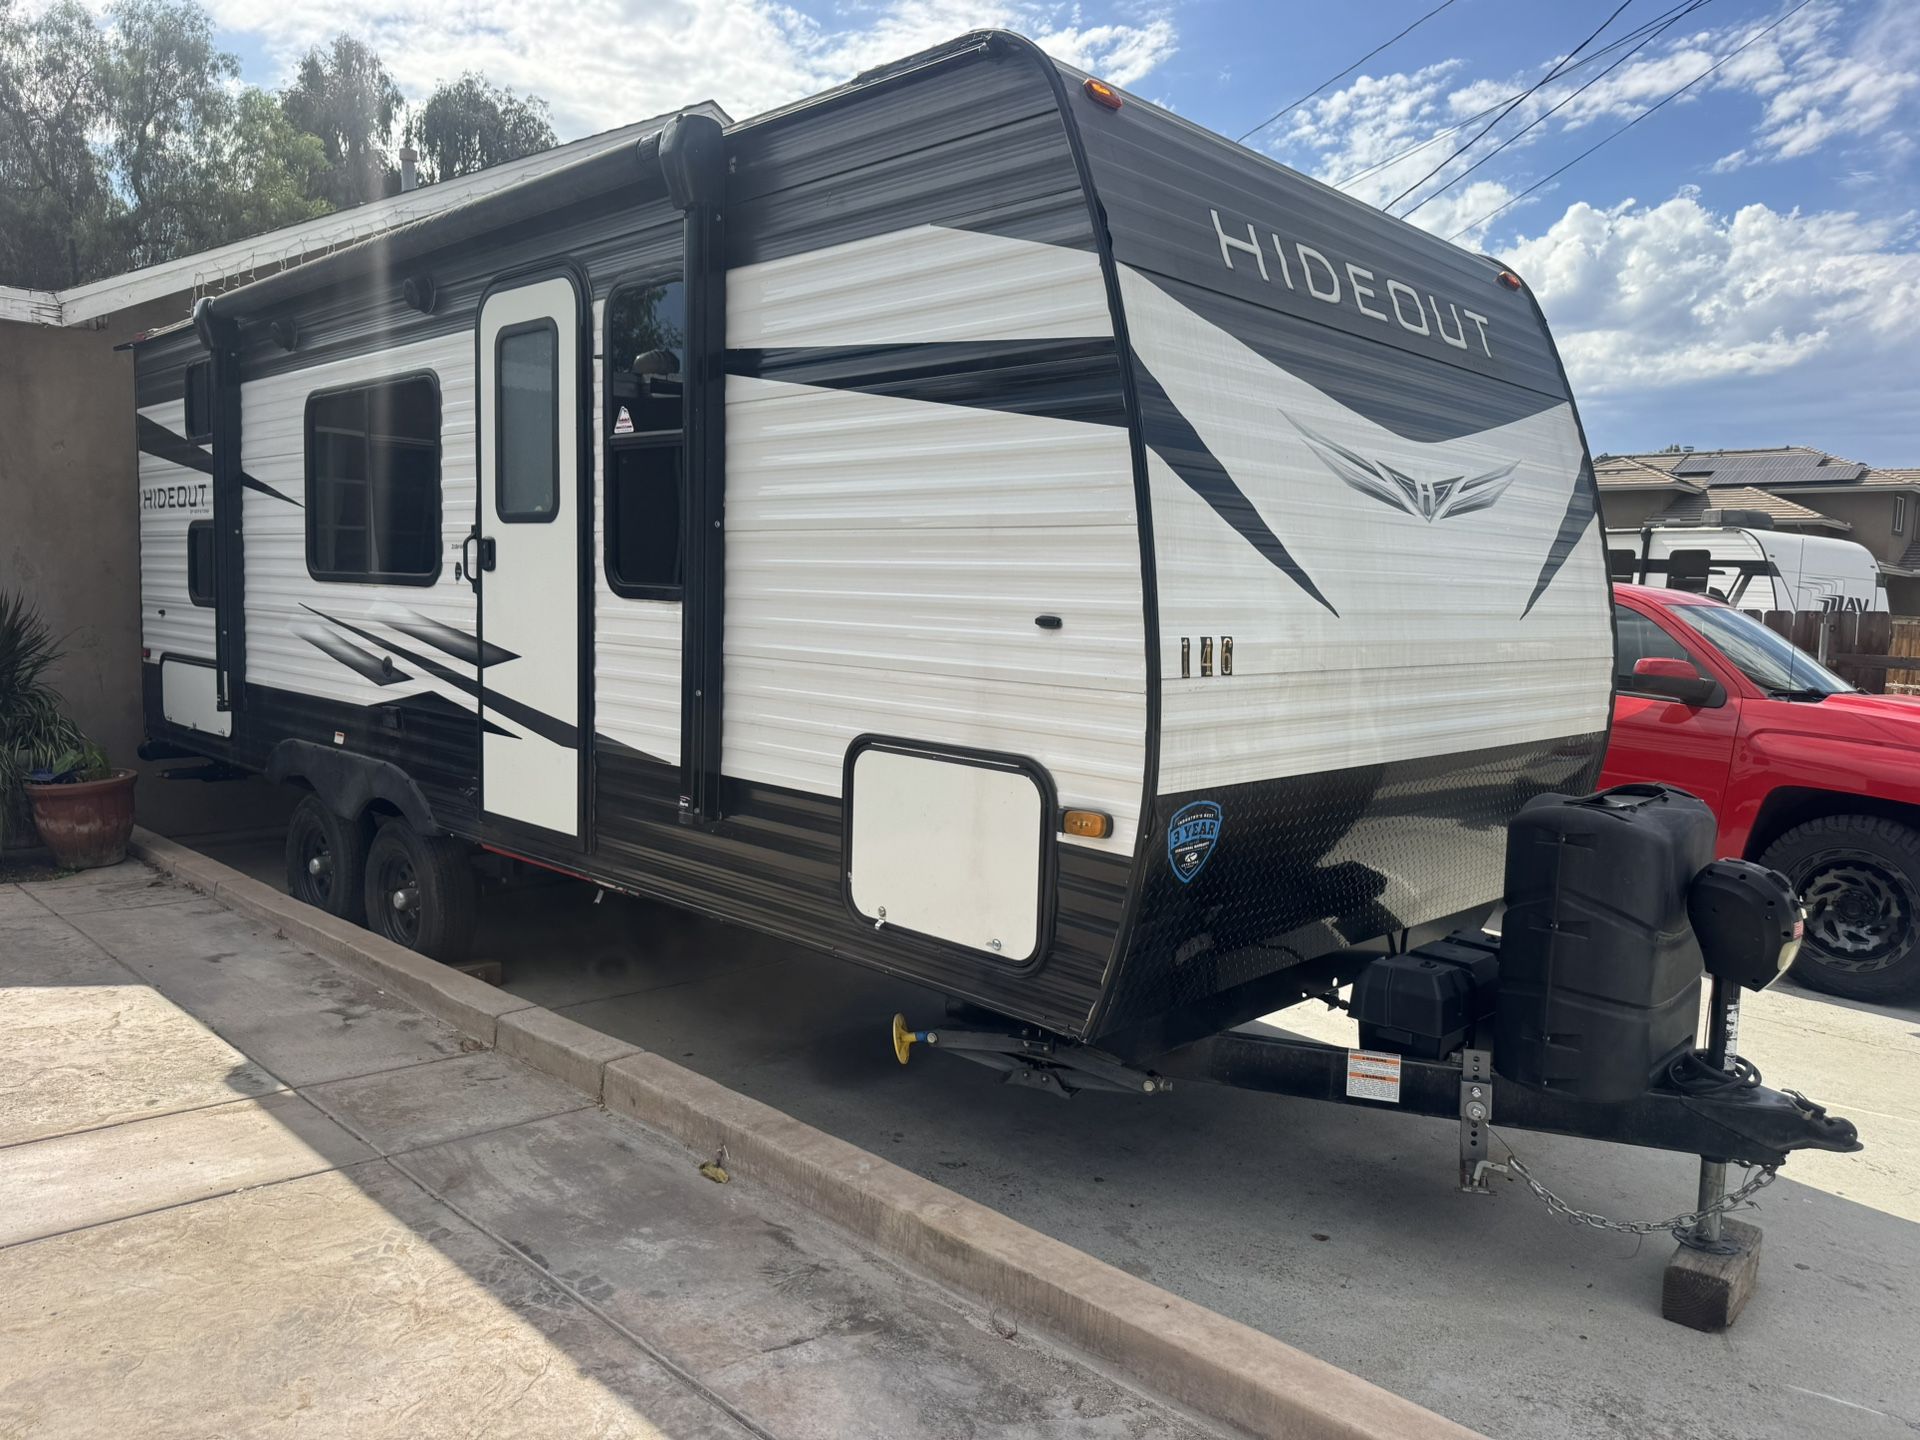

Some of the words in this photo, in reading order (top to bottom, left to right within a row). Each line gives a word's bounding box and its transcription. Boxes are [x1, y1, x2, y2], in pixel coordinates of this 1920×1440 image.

[1210, 208, 1492, 358] HIDEOUT
[143, 484, 207, 509] HIDEOUT
[1174, 830, 1180, 845] 3
[1184, 822, 1216, 839] YEAR
